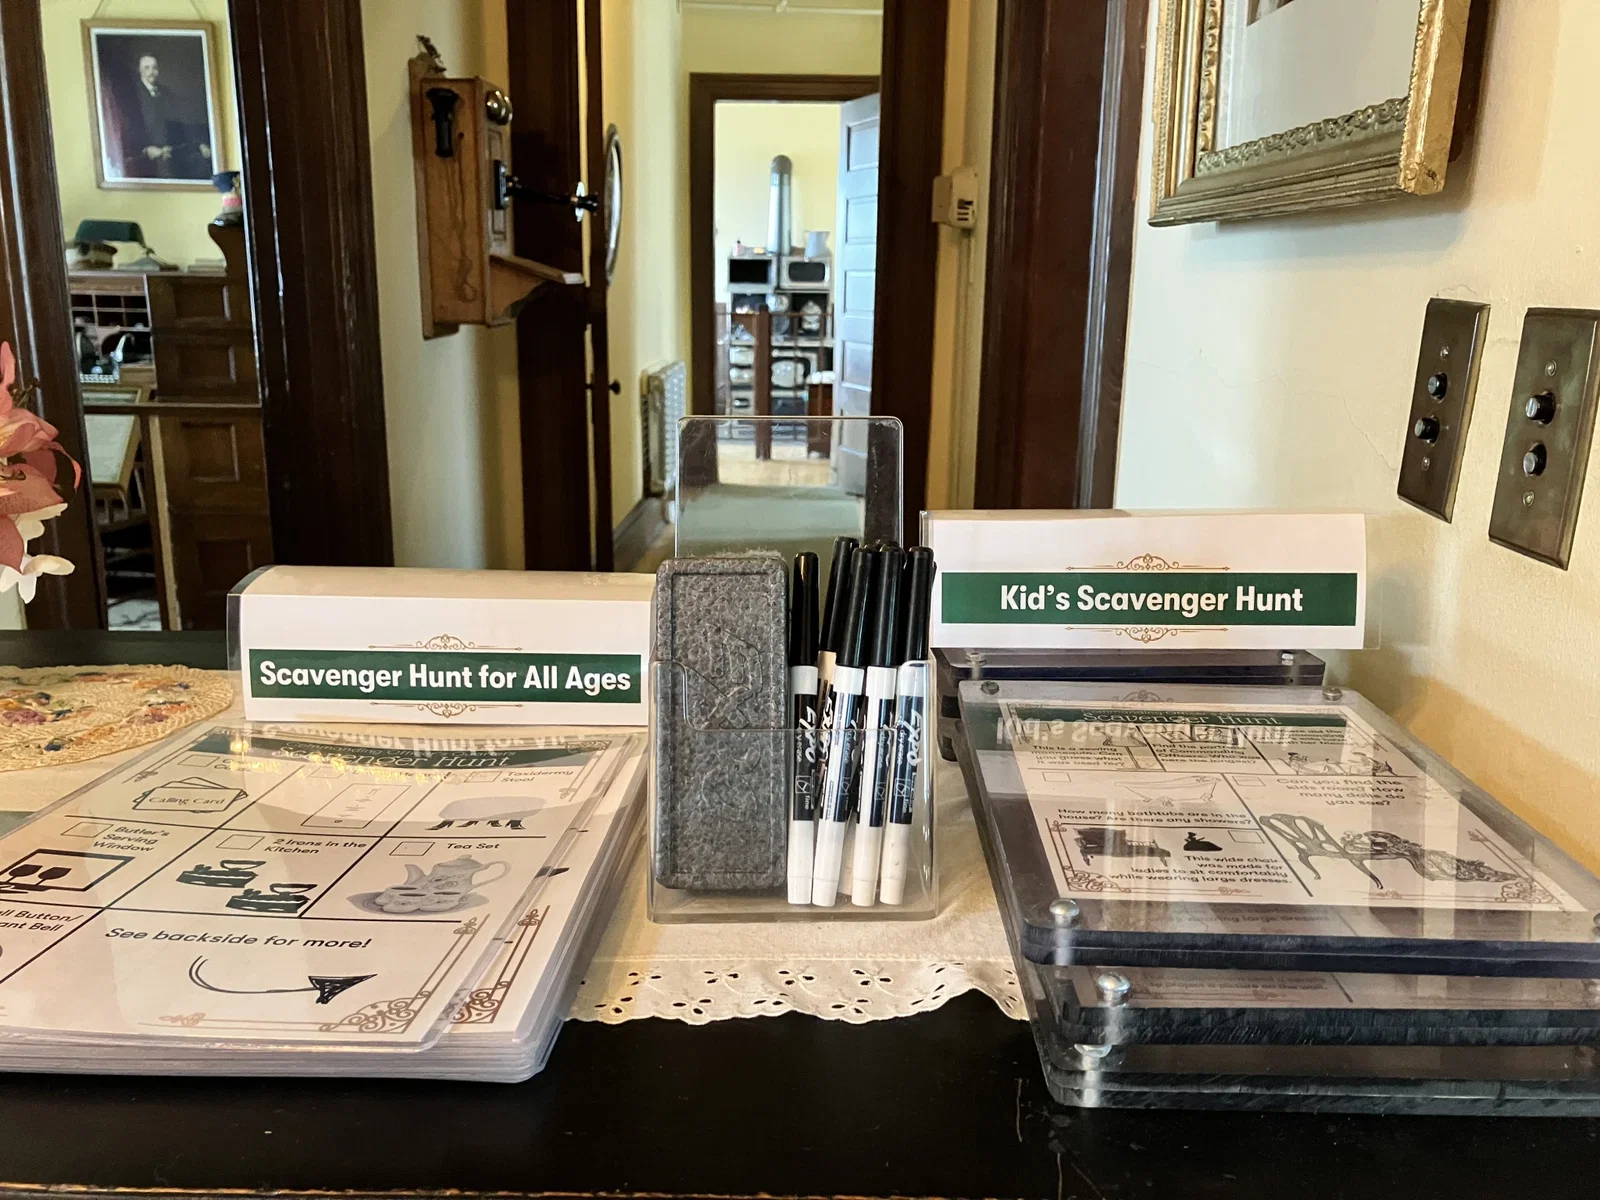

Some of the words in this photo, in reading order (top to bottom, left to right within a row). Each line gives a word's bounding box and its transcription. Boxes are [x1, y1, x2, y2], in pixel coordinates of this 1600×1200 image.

[1000, 584, 1070, 611] Kid's
[1076, 584, 1229, 618] Scavenger
[1236, 585, 1303, 611] Hunt
[260, 660, 402, 693] Scavenger
[409, 663, 473, 688] Hunt
[479, 664, 517, 688] for
[523, 665, 558, 689] All
[564, 665, 632, 696] Ages
[1083, 711, 1210, 724] Scavenger
[1216, 715, 1283, 725] Hunt
[286, 741, 382, 755] Commanding
[433, 756, 511, 767] Hunt
[193, 797, 226, 805] Card
[1194, 817, 1252, 825] showers?
[115, 826, 171, 837] Butler's
[103, 834, 158, 845] Serving
[286, 839, 323, 847] Irons
[93, 841, 155, 852] Window
[264, 846, 320, 854] Kitchen
[1145, 875, 1199, 883] wearing
[1208, 869, 1288, 878] comfortably
[14, 910, 84, 923] Button/
[28, 922, 64, 932] Bell
[105, 927, 148, 940] See
[152, 930, 259, 945] backside
[264, 935, 299, 947] for
[302, 938, 373, 949] more!
